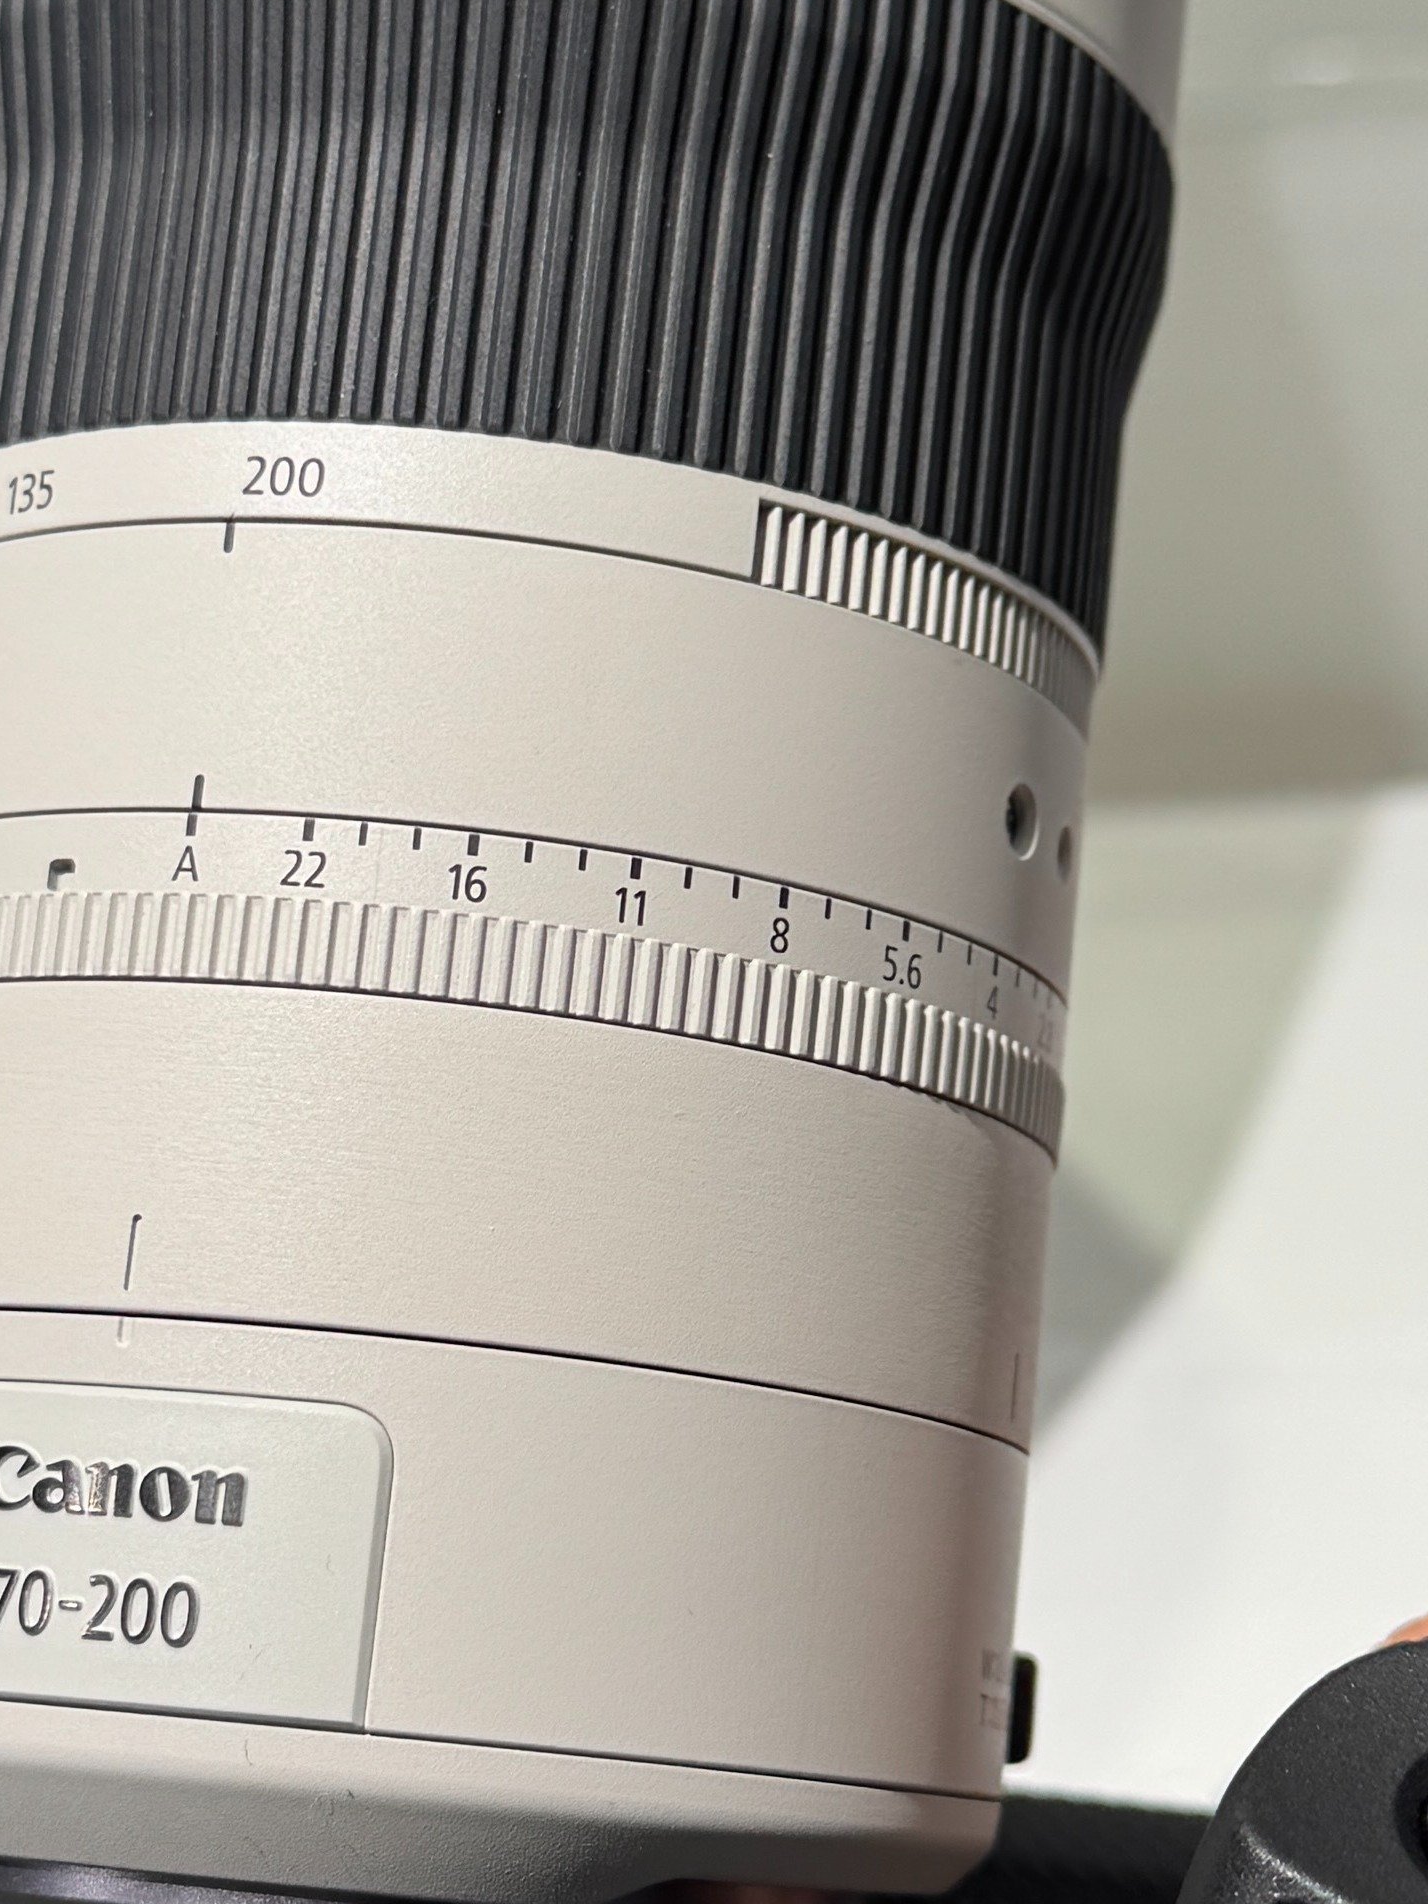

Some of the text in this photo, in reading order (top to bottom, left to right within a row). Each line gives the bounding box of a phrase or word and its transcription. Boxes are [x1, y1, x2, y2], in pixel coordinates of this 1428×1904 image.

[7, 469, 56, 515] 135
[241, 455, 327, 498] 200
[171, 845, 999, 1019] A 22 16 11 8 5.6 4
